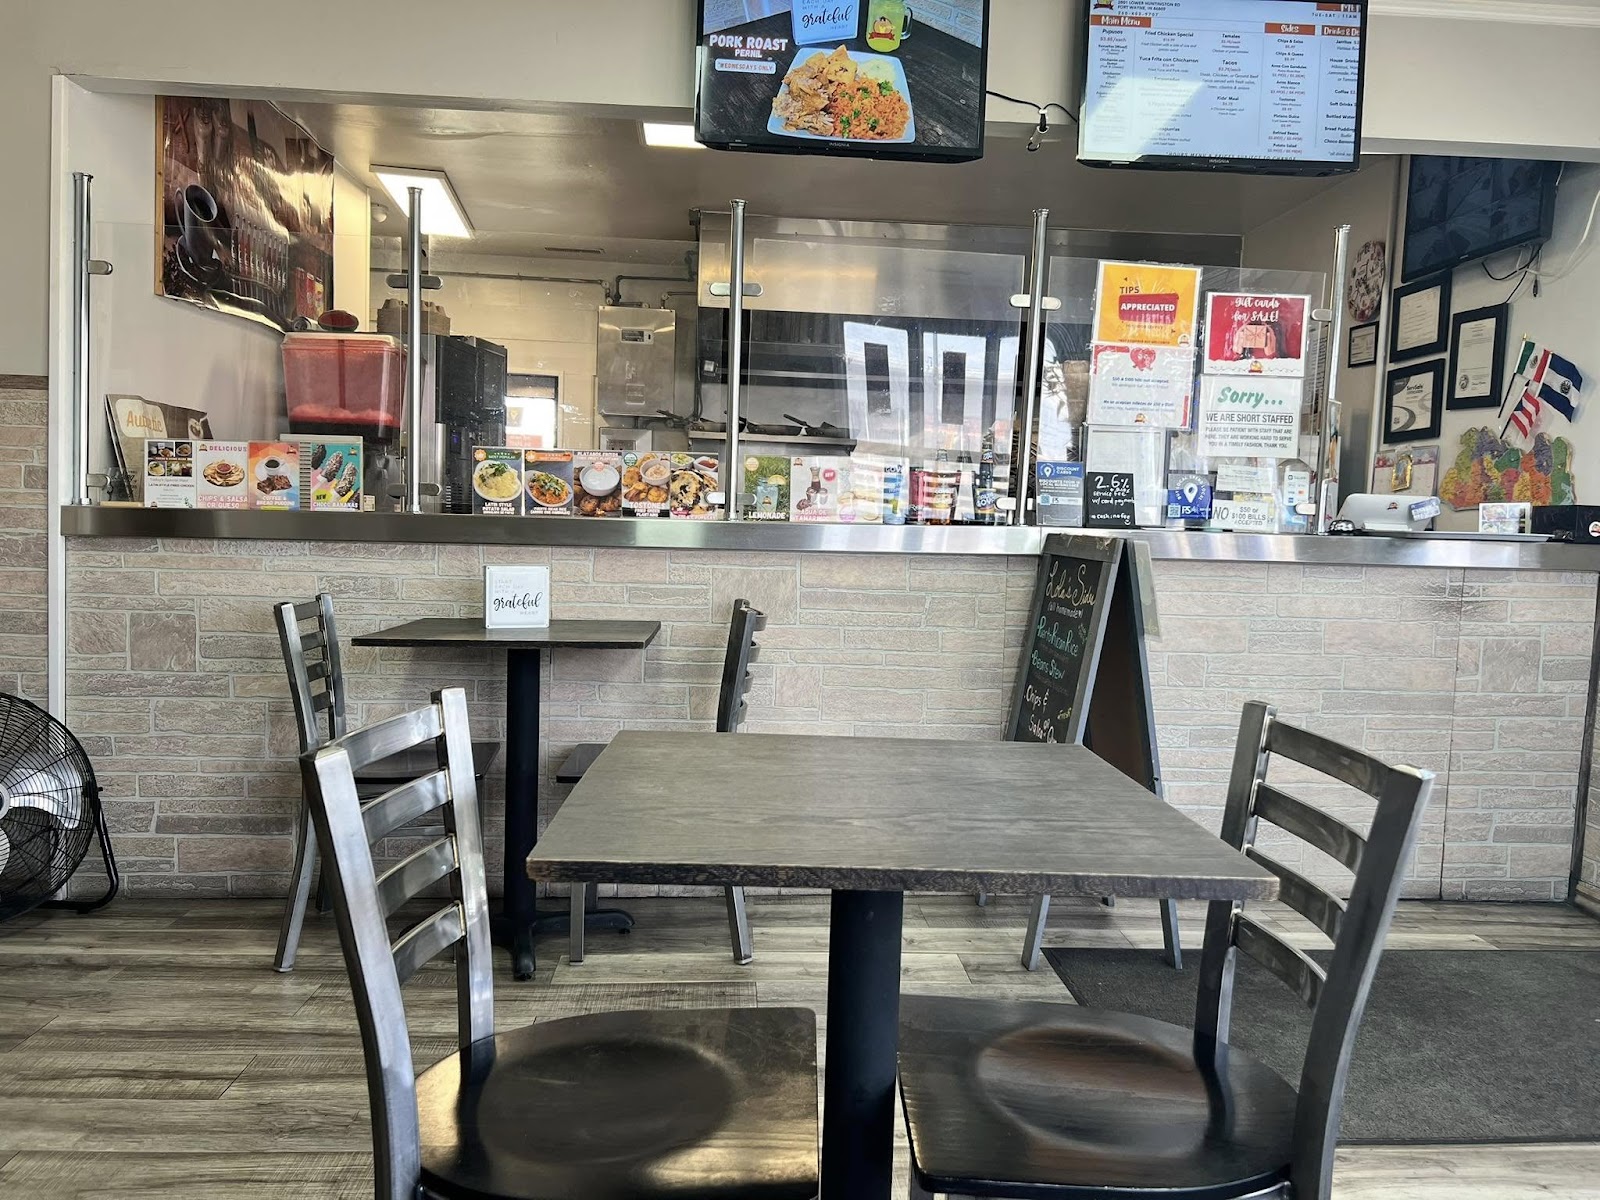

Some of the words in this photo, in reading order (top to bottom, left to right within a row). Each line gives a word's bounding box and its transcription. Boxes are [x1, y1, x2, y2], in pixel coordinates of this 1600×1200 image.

[802, 5, 853, 28] grateful
[1101, 15, 1120, 25] Main
[1120, 16, 1141, 26] Menu
[1280, 24, 1299, 33] Sides
[1323, 27, 1345, 35] Drinks
[709, 34, 743, 48] PORK
[746, 36, 788, 51] ROAST
[734, 49, 763, 58] PERNIL
[1119, 286, 1140, 294] TIPS
[1120, 303, 1175, 311] APPRECIATED
[1254, 298, 1280, 309] cards
[1231, 310, 1250, 322] for
[1250, 310, 1279, 322] SALE!
[1217, 386, 1283, 409] Sorry...
[1206, 413, 1218, 421] WE
[1219, 413, 1235, 422] ARE
[1236, 413, 1261, 422] SHORT
[1262, 414, 1294, 424] STAFFED
[1094, 474, 1130, 489] 2.6%
[629, 501, 666, 509] TOSTONES
[748, 511, 786, 519] LEMONADE
[1212, 507, 1229, 520] NO
[1231, 512, 1246, 520] $100
[493, 592, 544, 612] grateful
[1026, 684, 1042, 711] Chips
